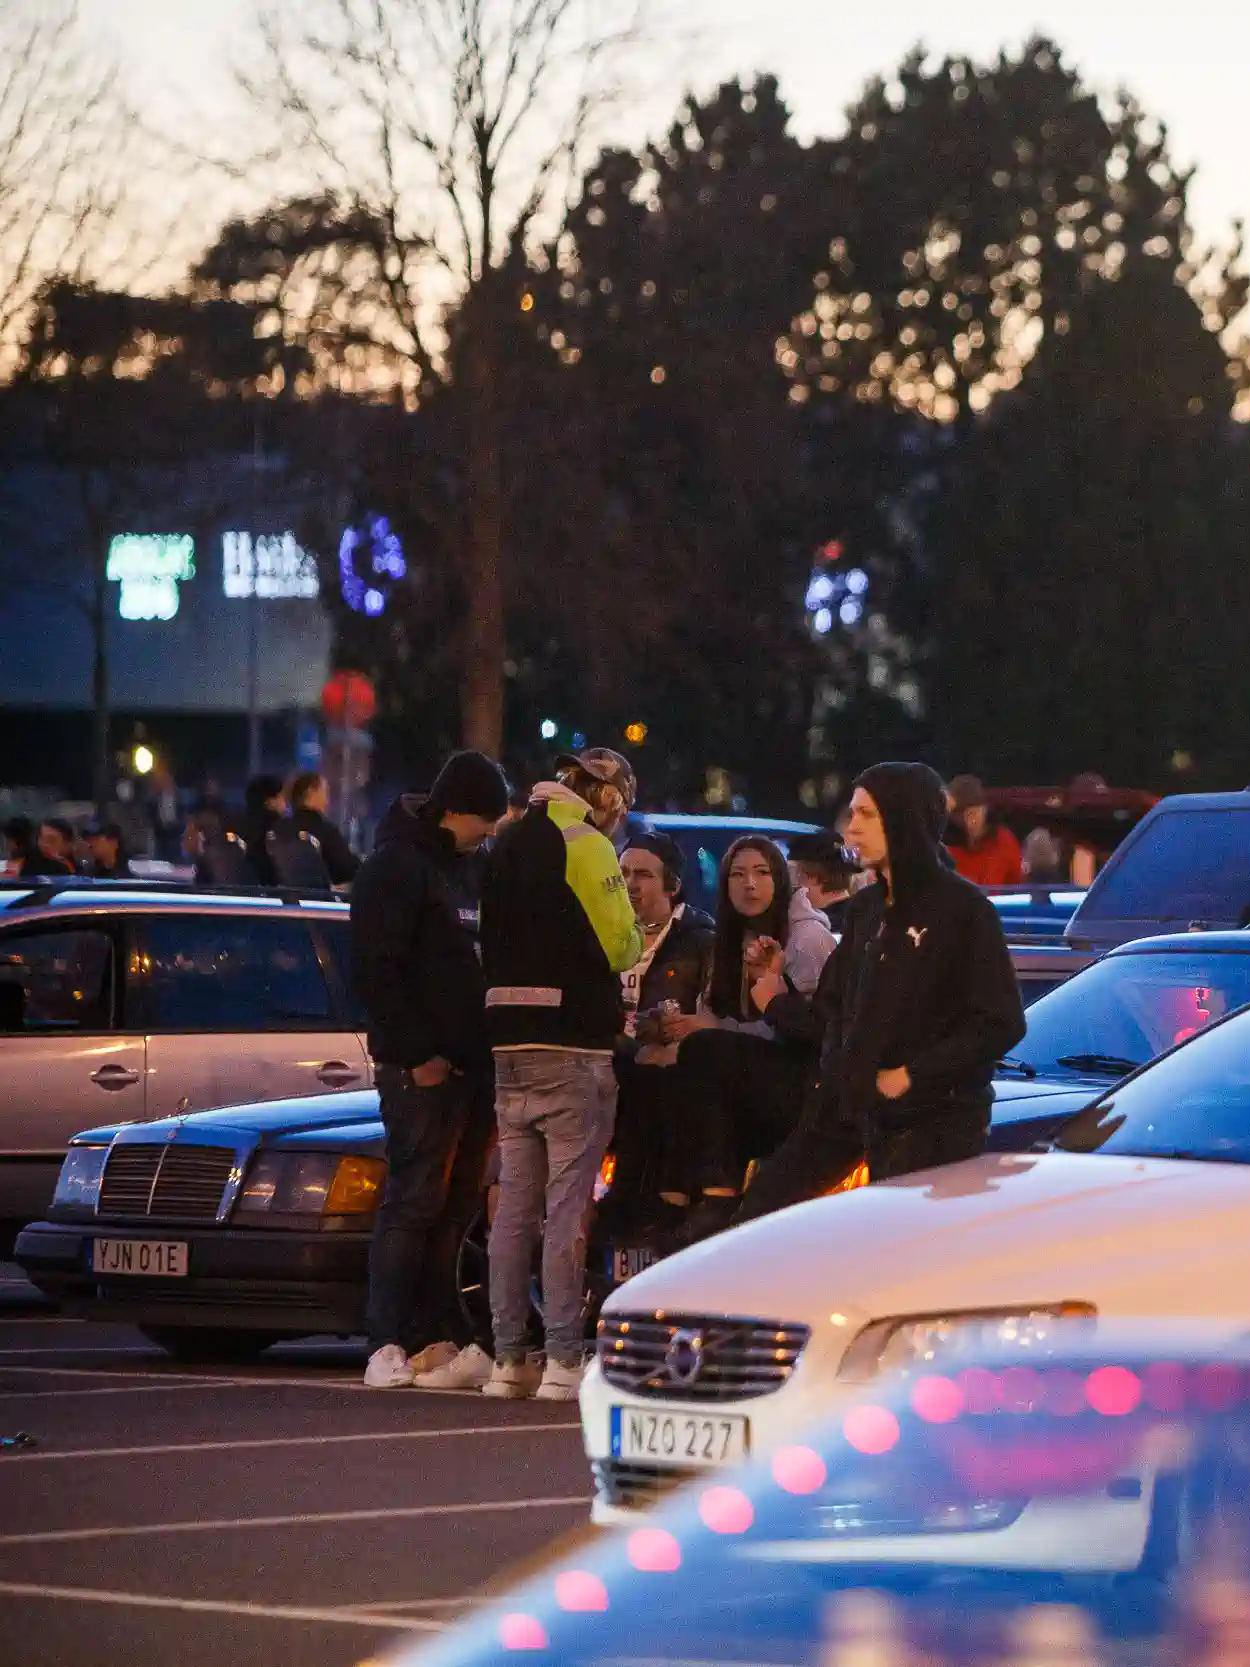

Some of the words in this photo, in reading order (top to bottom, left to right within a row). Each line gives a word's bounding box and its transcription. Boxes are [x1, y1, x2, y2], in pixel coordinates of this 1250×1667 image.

[100, 1241, 132, 1271] YJN
[140, 1243, 177, 1272] 01E
[630, 1416, 676, 1454] NZO
[685, 1419, 733, 1460] 227
